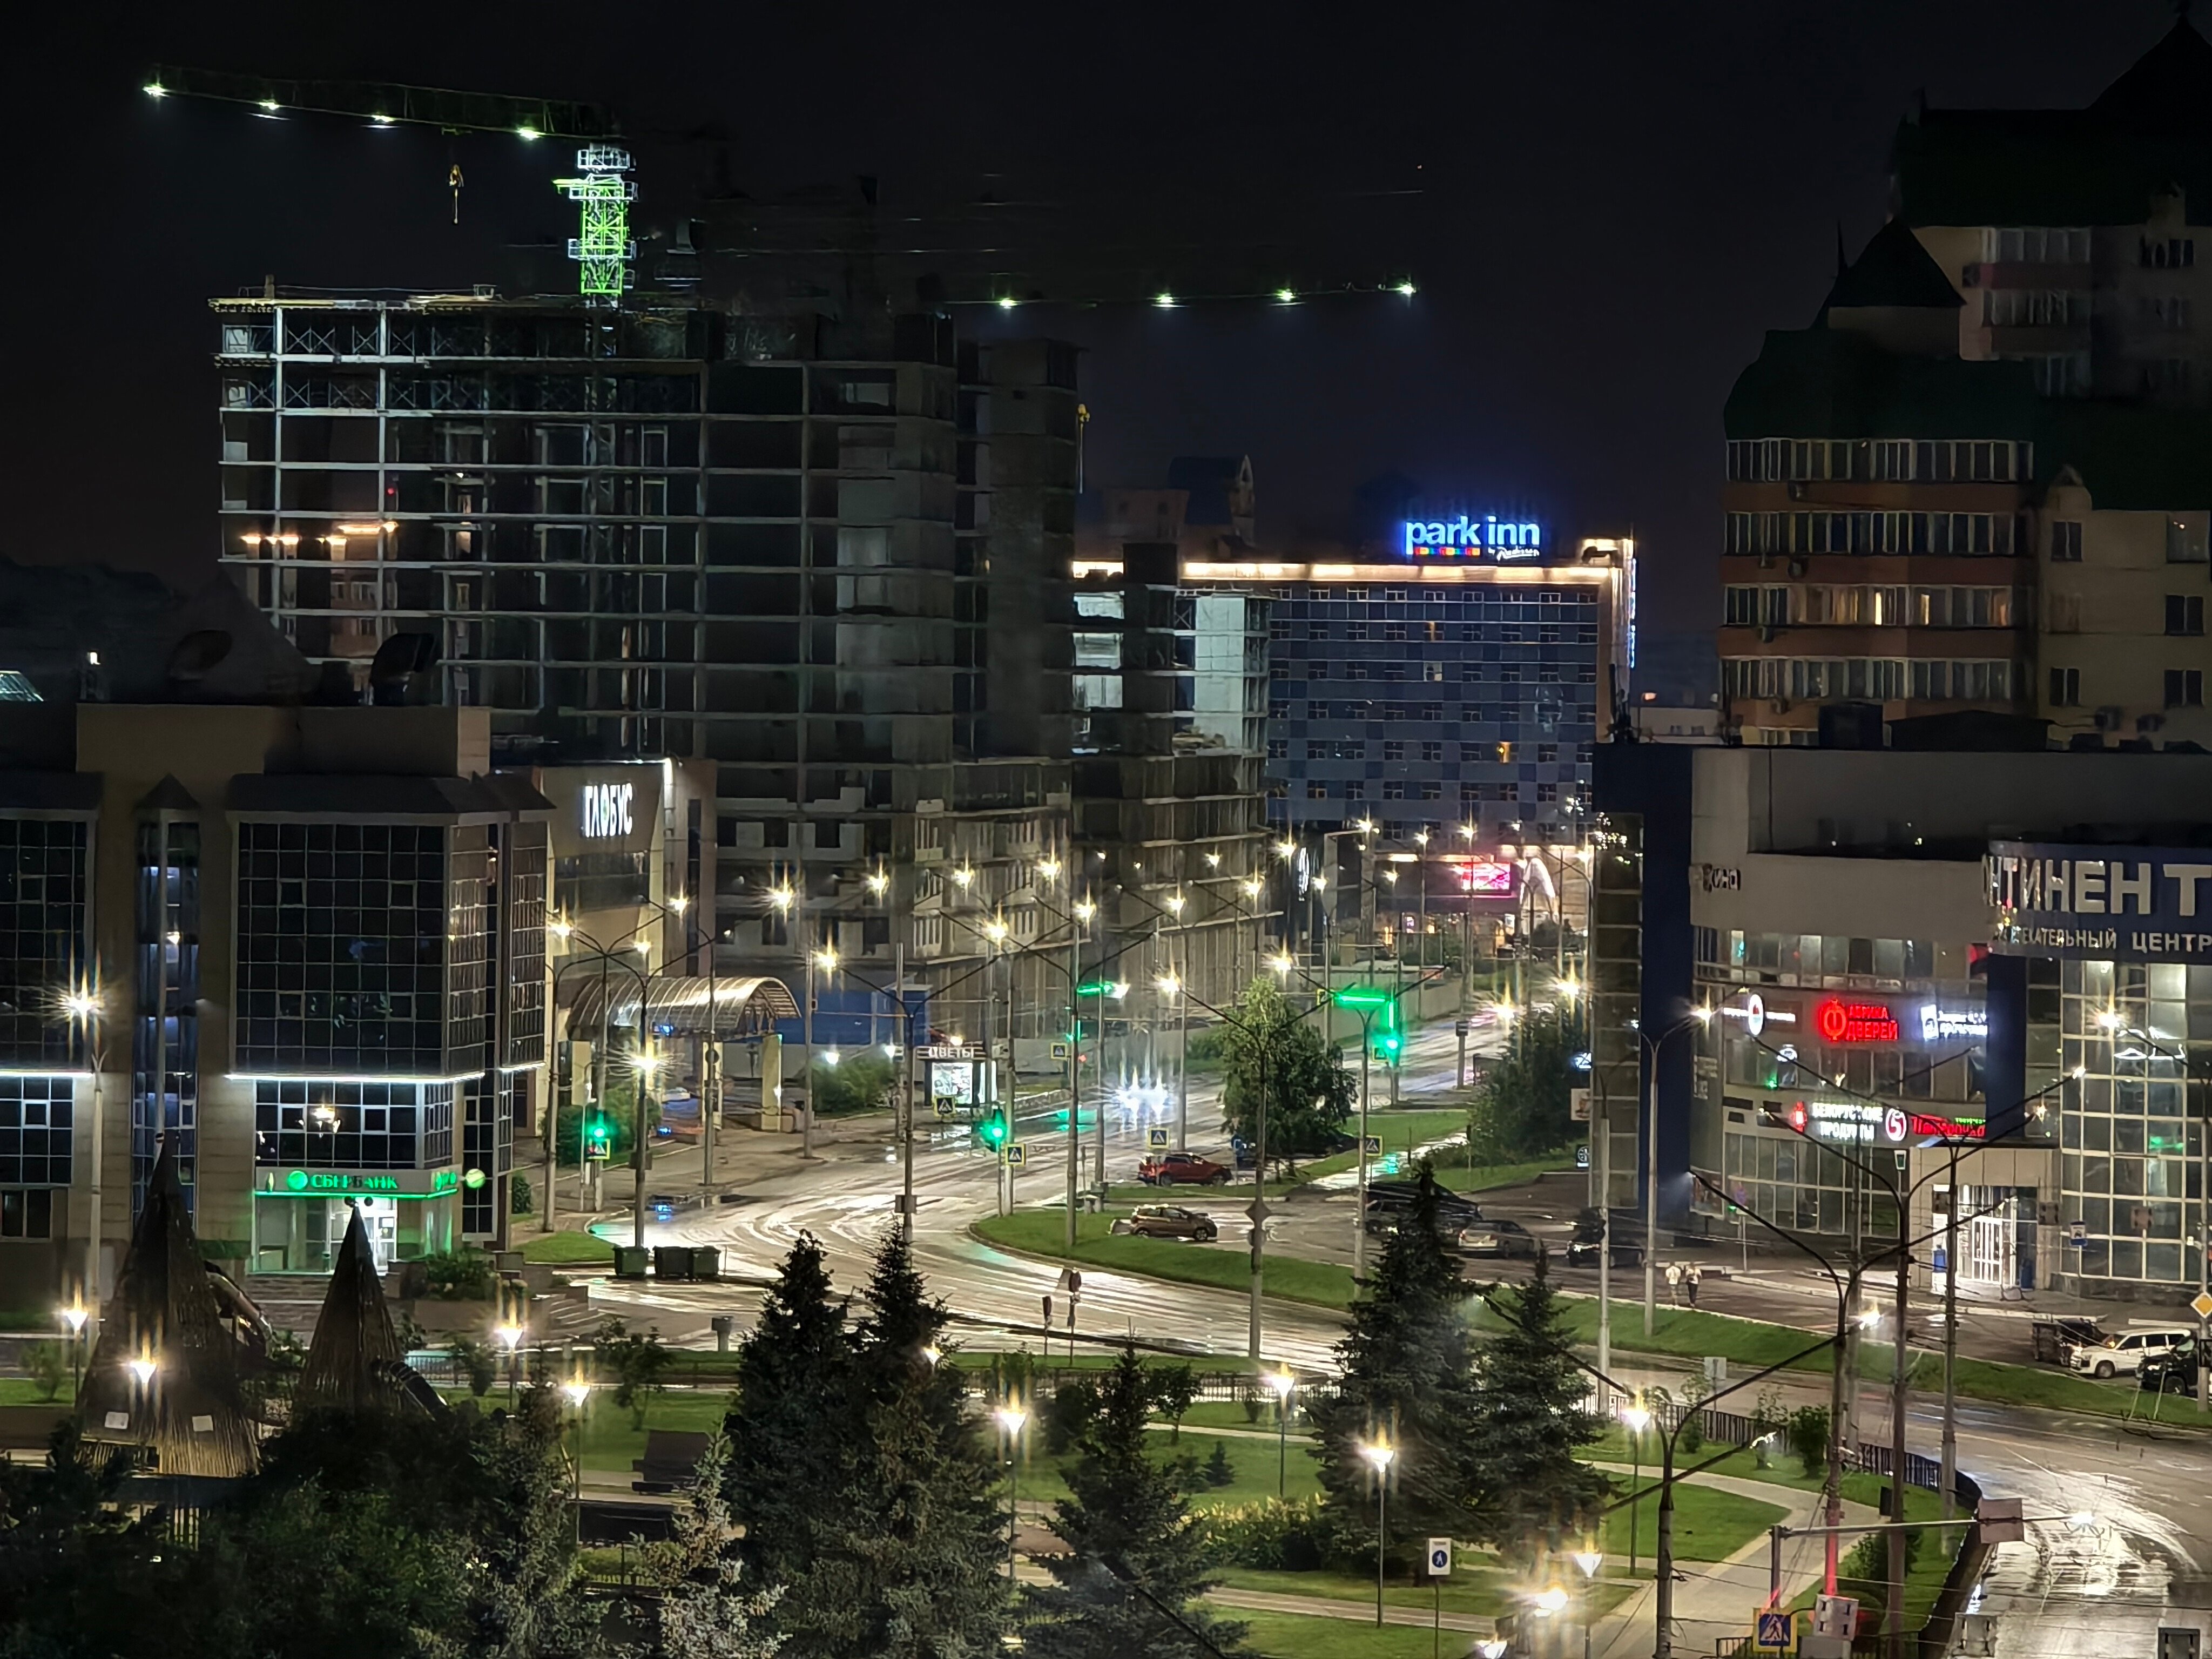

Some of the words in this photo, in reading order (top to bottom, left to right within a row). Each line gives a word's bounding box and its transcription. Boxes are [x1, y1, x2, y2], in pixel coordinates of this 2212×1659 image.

[1406, 516, 1481, 555] park
[1488, 516, 1540, 544] inn
[585, 783, 632, 837] ГЛОБУС
[2132, 932, 2211, 954] ЦЕНТР
[1845, 1020, 1898, 1041] ДВЕРЕЙ
[928, 1047, 974, 1059] ЦВЕТЫ
[1820, 1121, 1874, 1140] ПРОДУТЫ
